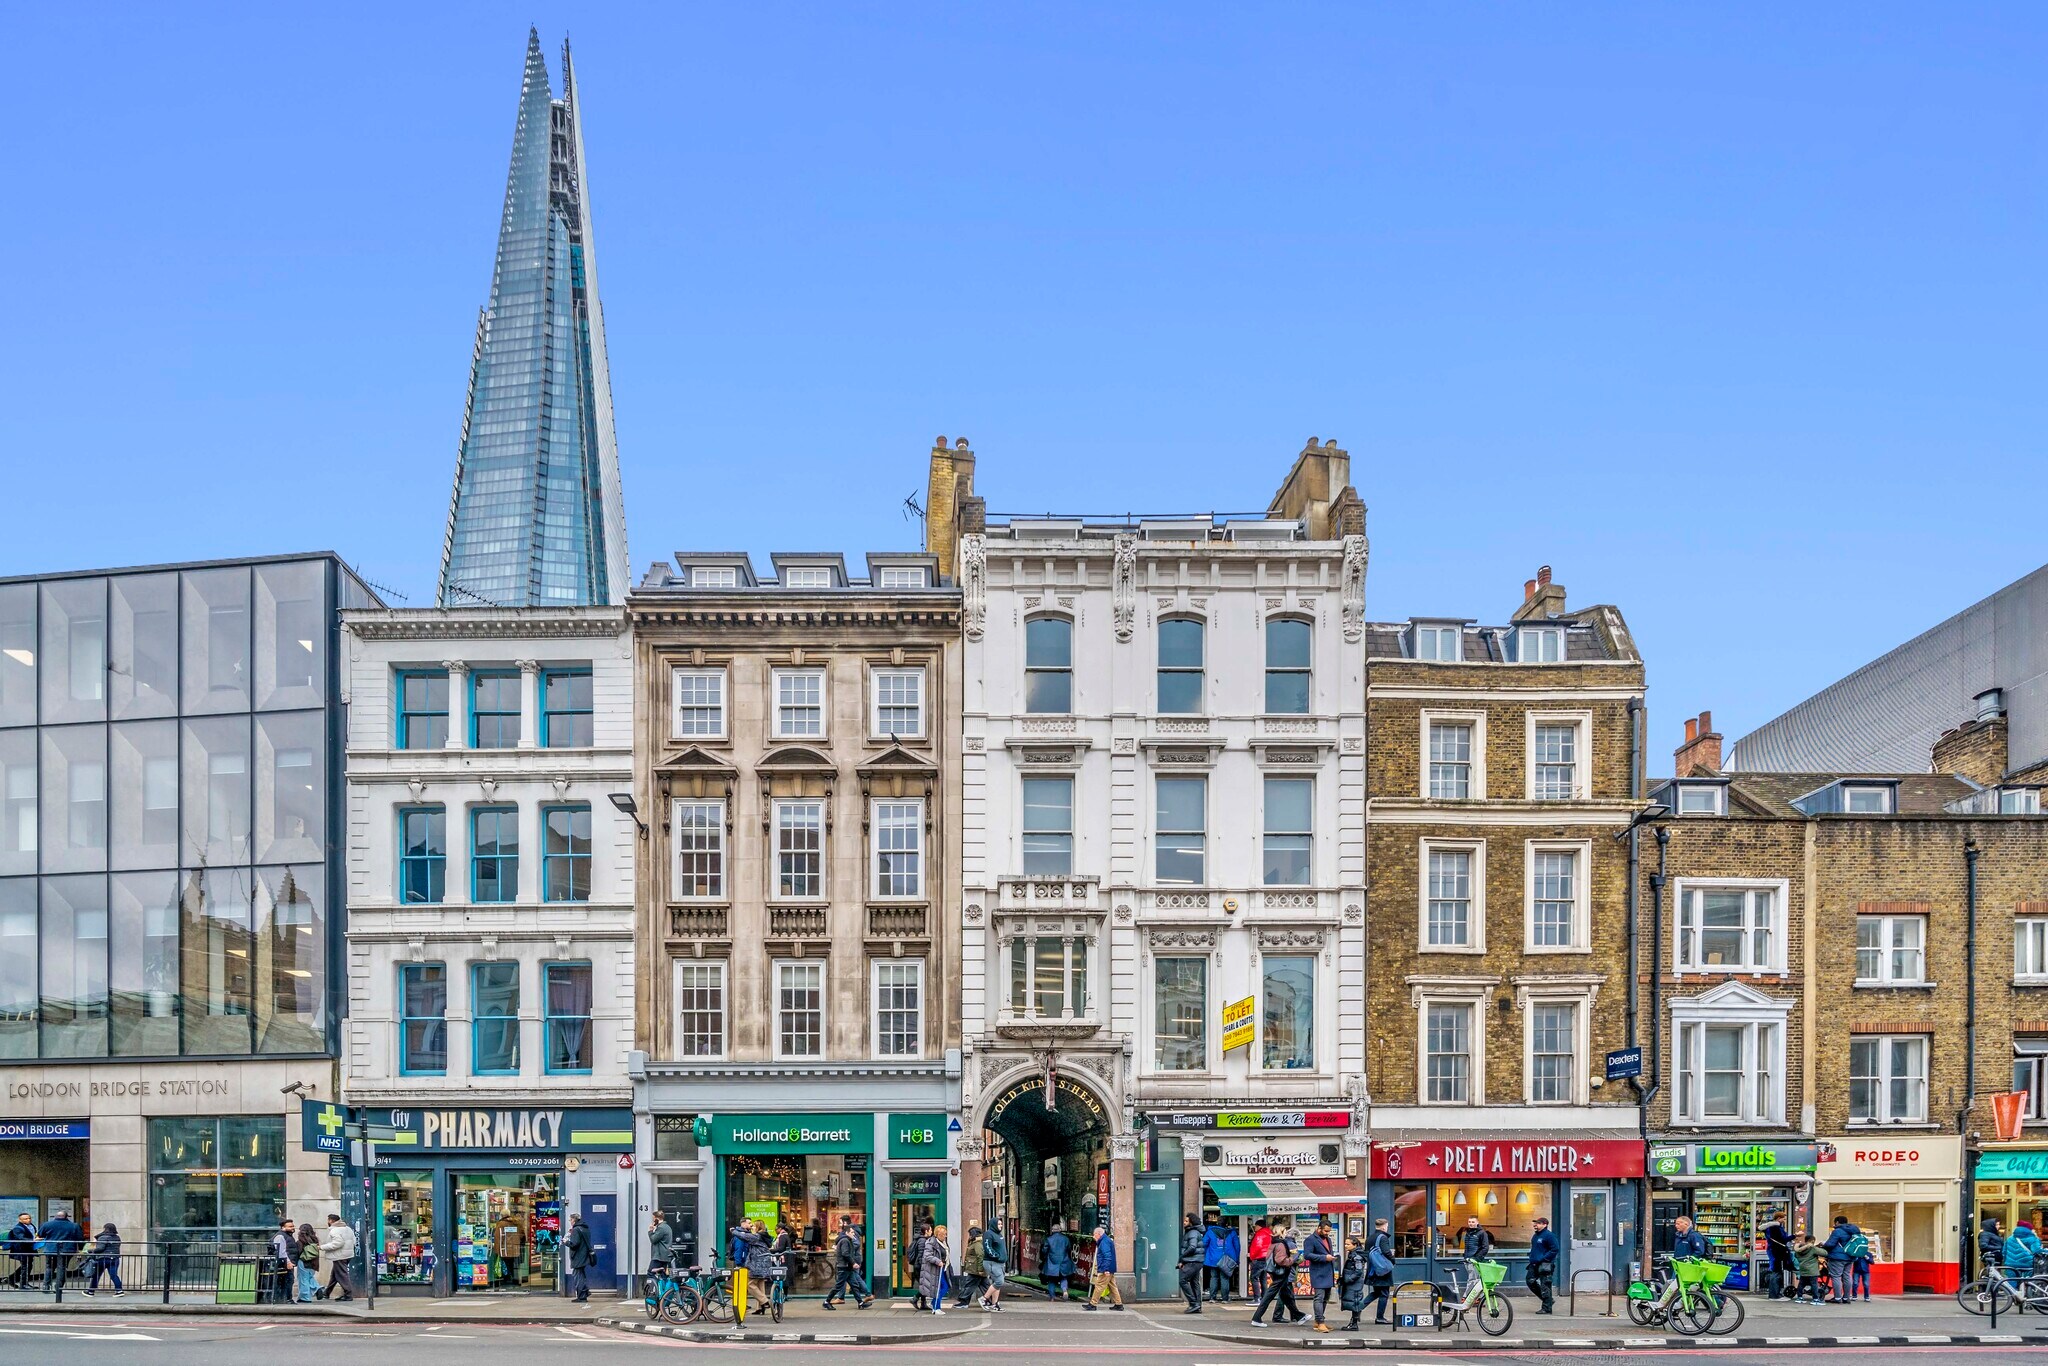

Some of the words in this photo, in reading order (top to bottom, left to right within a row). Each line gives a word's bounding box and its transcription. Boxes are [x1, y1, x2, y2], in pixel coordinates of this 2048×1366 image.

[1226, 1012, 1235, 1023] TO
[1237, 1004, 1251, 1019] LET
[1608, 1053, 1639, 1066] Dexters
[9, 1082, 81, 1099] LONDON
[90, 1081, 151, 1097] BRIDGE
[159, 1080, 228, 1095] STATION
[994, 1090, 1017, 1113] OLD
[1070, 1084, 1101, 1113] HEAD
[390, 1109, 410, 1129] City
[1226, 1113, 1279, 1125] Ristorante
[1281, 1114, 1290, 1125] &
[30, 1124, 69, 1135] BRIDGE
[423, 1111, 564, 1148] PHARMACY
[320, 1137, 341, 1148] NHS
[1264, 1146, 1279, 1156] the
[1654, 1148, 1682, 1157] Londis
[1703, 1145, 1776, 1166] Londis
[1855, 1150, 1919, 1162] RODEO
[509, 1157, 523, 1165] 020
[524, 1157, 542, 1167] 7407
[543, 1157, 560, 1165] 2061
[1226, 1151, 1317, 1165] luncheonette
[1445, 1146, 1486, 1173] PRET
[1491, 1146, 1503, 1172] A
[1511, 1146, 1578, 1172] MANGER
[1247, 1165, 1269, 1174] take
[1269, 1166, 1296, 1176] away
[1661, 1160, 1676, 1170] 24
[2007, 1157, 2040, 1174] Café
[638, 1204, 649, 1212] 43
[1404, 1316, 1413, 1326] P
